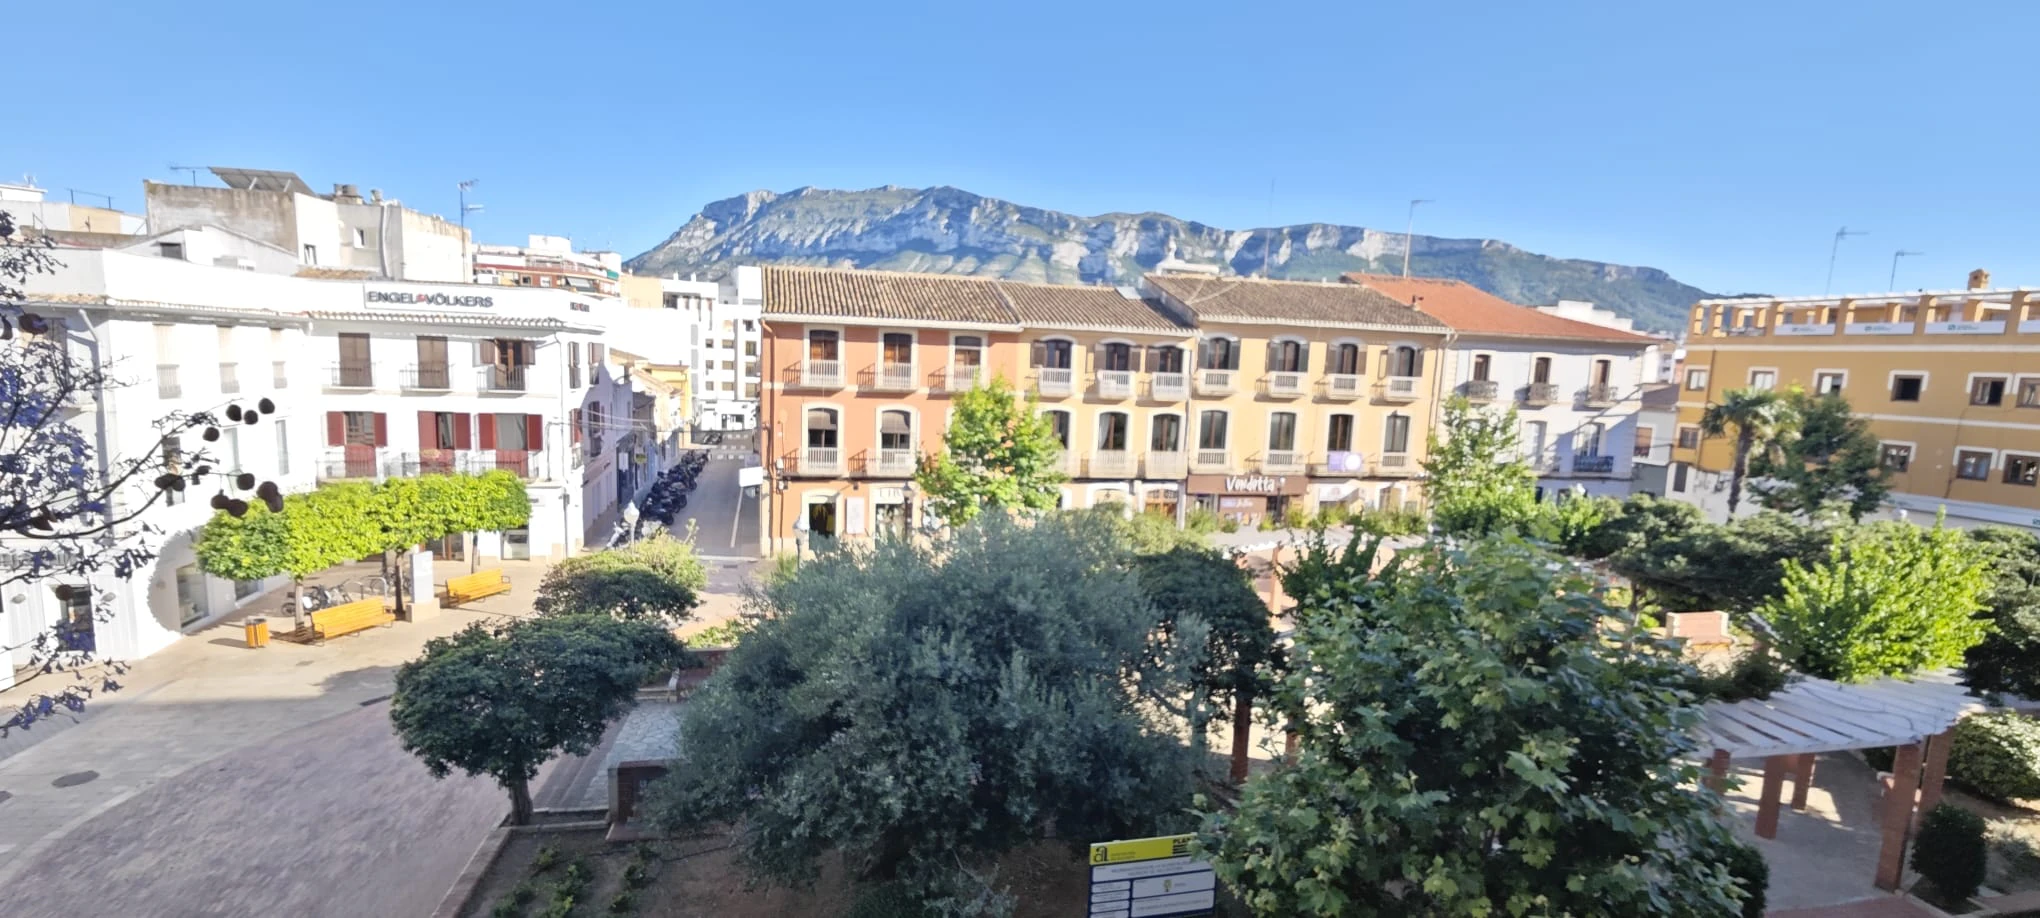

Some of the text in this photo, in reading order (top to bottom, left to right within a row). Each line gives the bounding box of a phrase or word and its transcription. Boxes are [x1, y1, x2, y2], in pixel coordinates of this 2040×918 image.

[368, 291, 493, 307] ENGEL VÖLKERS
[1226, 475, 1275, 492] Vendetta
